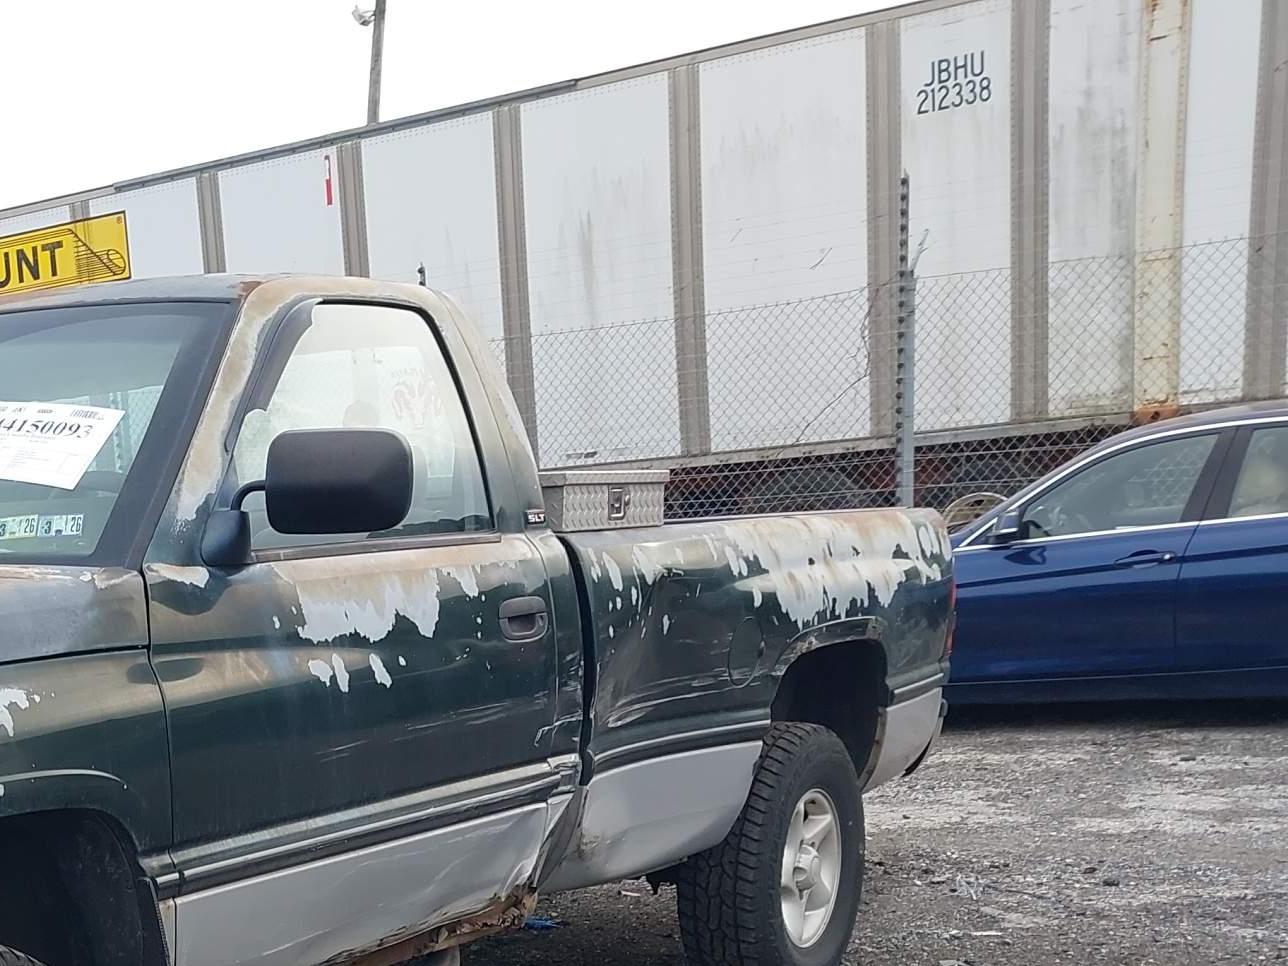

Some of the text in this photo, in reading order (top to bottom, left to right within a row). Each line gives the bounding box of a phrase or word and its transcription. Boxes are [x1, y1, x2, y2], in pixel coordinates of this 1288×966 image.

[923, 50, 985, 87] JBHU
[915, 76, 992, 115] 212338
[23, 518, 35, 534] 26
[70, 516, 82, 533] 26
[527, 512, 545, 523] SLT
